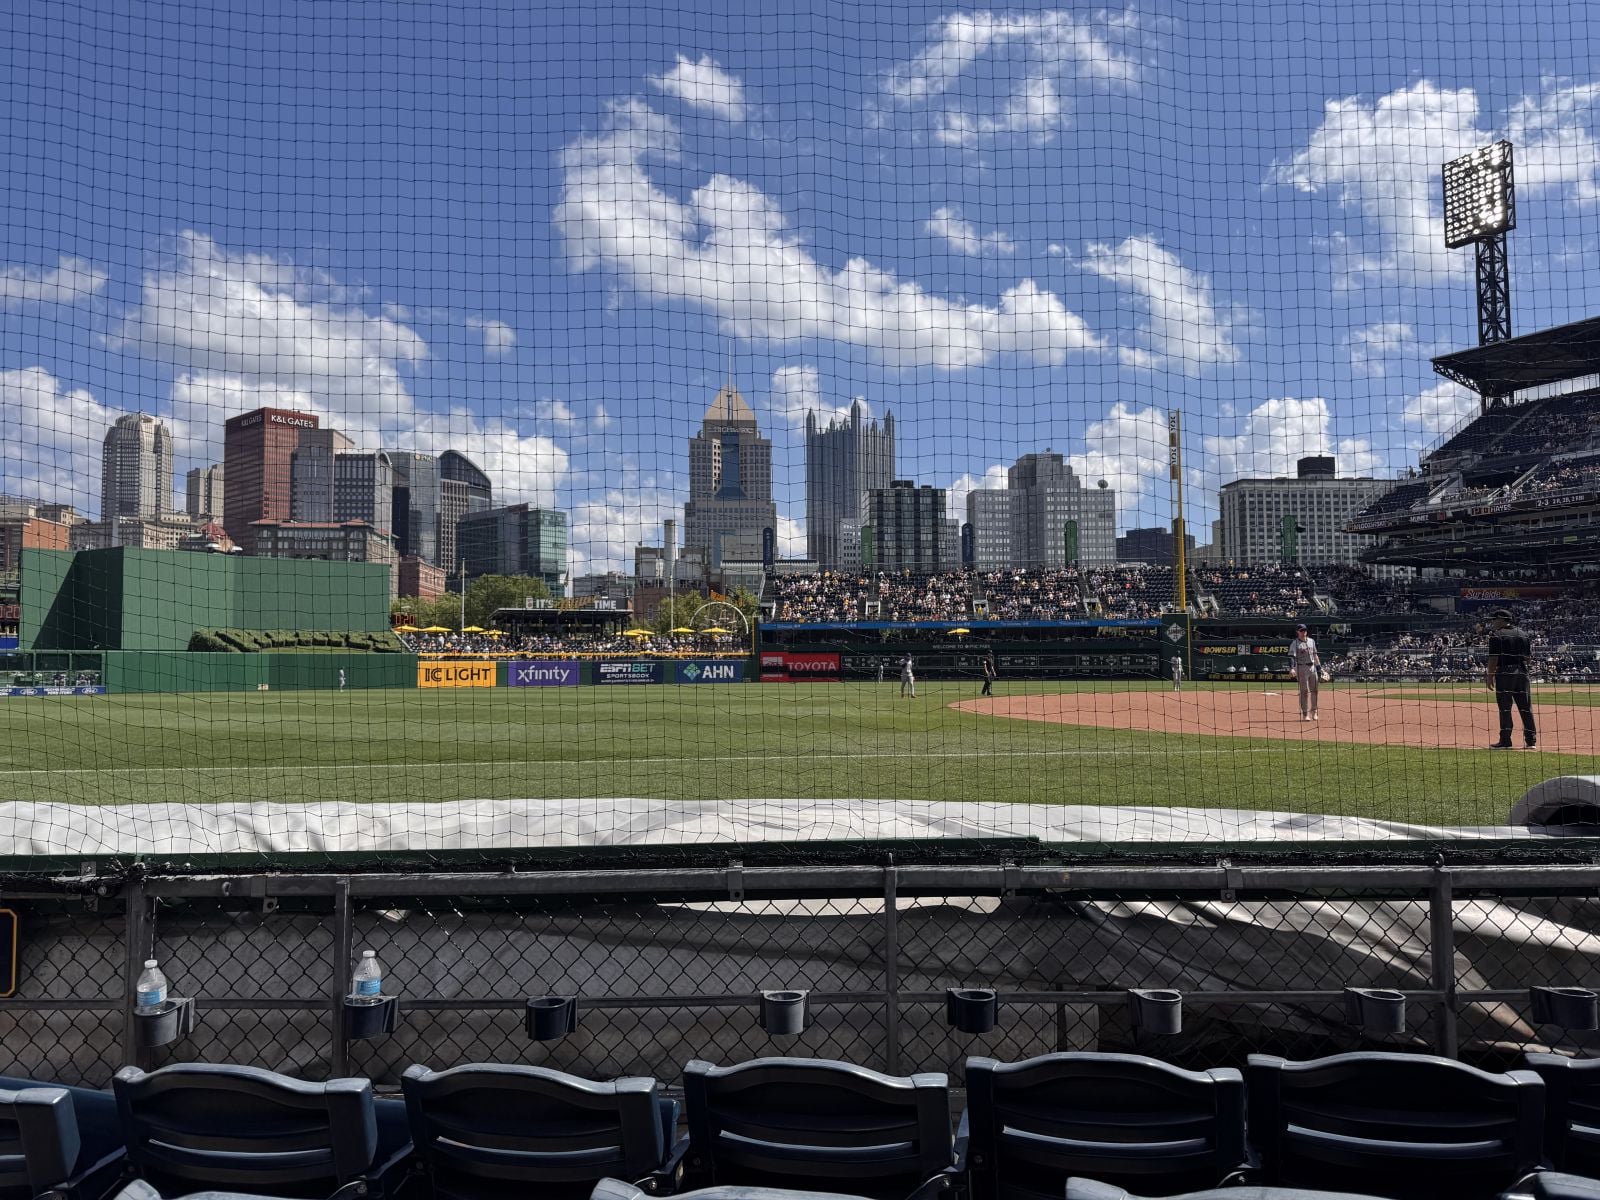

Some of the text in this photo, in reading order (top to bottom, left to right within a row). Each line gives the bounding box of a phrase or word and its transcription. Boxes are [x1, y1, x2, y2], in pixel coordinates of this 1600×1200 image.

[271, 414, 314, 428] K&L GATES
[593, 600, 617, 610] TIME
[1204, 646, 1237, 654] BOWSER
[600, 663, 656, 673] ESPN BET
[702, 665, 734, 679] AHN
[786, 661, 837, 672] TOYOTA
[425, 668, 490, 682] IC LIGHT
[517, 665, 570, 682] xfinity
